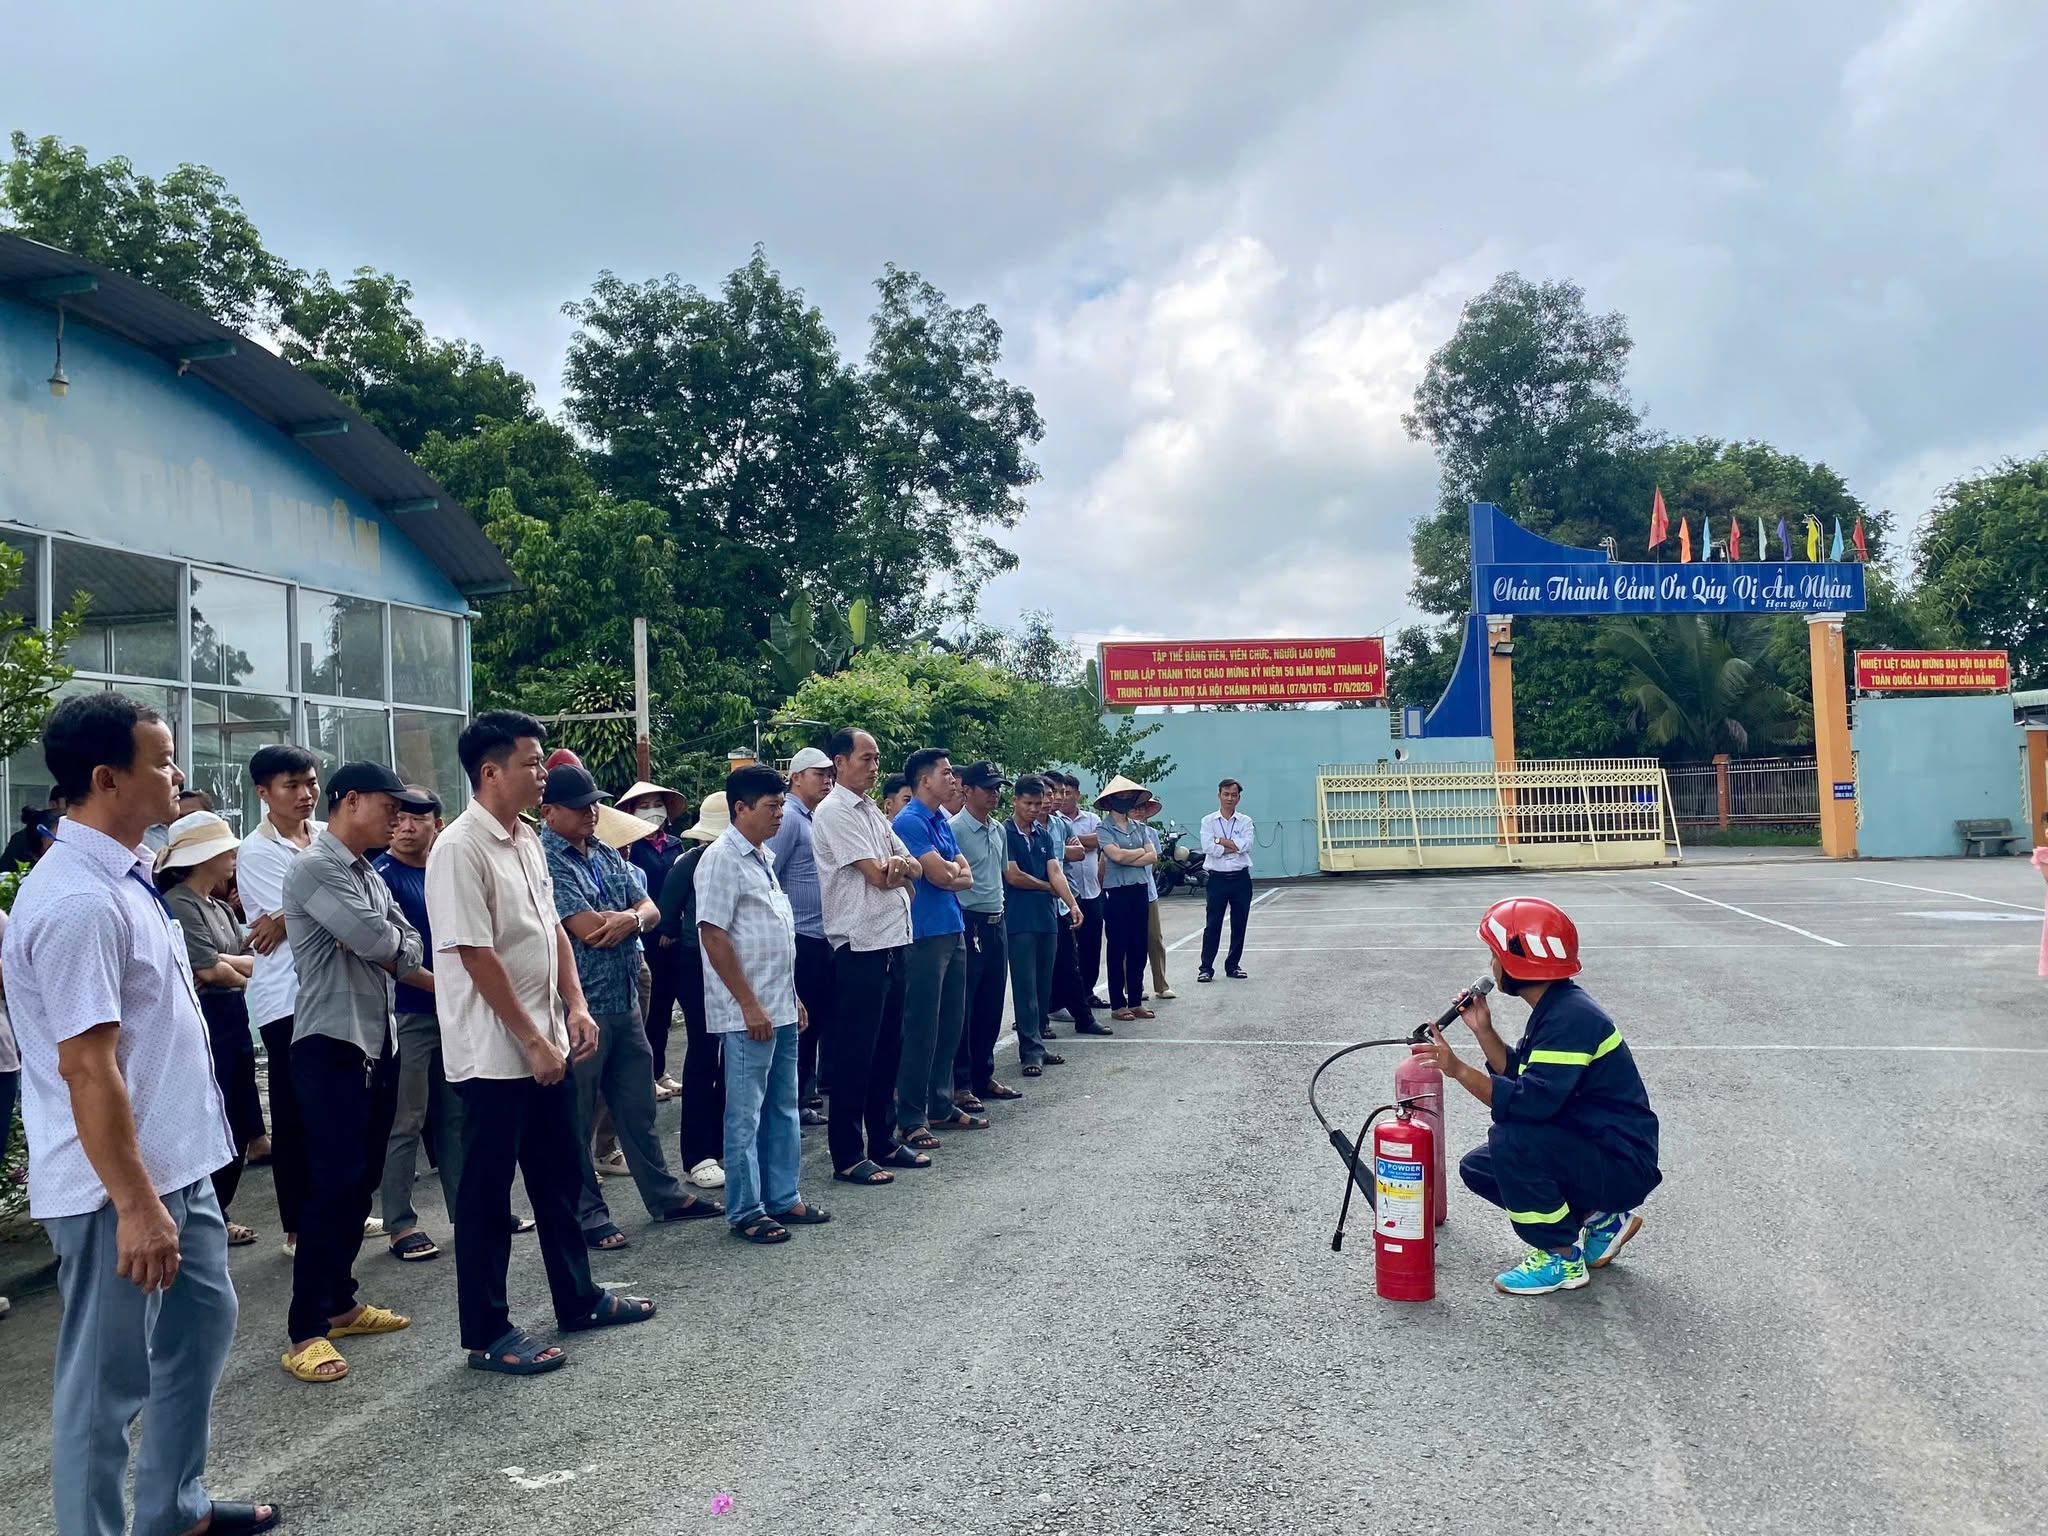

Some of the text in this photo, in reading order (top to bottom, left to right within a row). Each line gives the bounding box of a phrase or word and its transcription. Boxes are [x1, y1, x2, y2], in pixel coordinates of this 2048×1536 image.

[1493, 577, 1542, 601] Chân
[1547, 576, 1610, 601] Thành
[1614, 575, 1656, 600] Cảm
[1661, 573, 1687, 600] Ơn
[1733, 575, 1759, 605] Vị
[1762, 568, 1796, 599] Ân
[1800, 574, 1853, 599] Nhân
[1765, 600, 1787, 610] Hẹn
[1230, 647, 1247, 660] VIÊN
[1299, 649, 1313, 658] LAO
[1314, 647, 1336, 660] ĐỘNG
[1901, 657, 1920, 669] CHÀO
[1110, 670, 1121, 680] THI
[1141, 667, 1155, 682] LẬP
[1157, 667, 1183, 680] THÀNH
[1184, 666, 1202, 679] TÍCH
[1204, 666, 1224, 679] CHÀO
[1226, 665, 1249, 678] MỪNG
[1263, 664, 1282, 679] NIỆM
[1285, 667, 1294, 677] 50
[1296, 664, 1314, 676] NĂM
[1316, 663, 1335, 676] NGÀY
[1338, 662, 1362, 675] THÀNH
[1364, 662, 1378, 677] LẬP
[1946, 675, 1958, 685] XIV
[1117, 687, 1142, 698] TRUNG
[1145, 685, 1160, 697] TÂM
[1163, 683, 1178, 697] BẢO
[1197, 684, 1207, 696] XÃ
[1209, 683, 1222, 698] HỘI
[1224, 683, 1250, 696] CHÁNH
[1252, 682, 1267, 695] PHÚ
[1287, 683, 1327, 694] (07/9/1976
[1333, 682, 1373, 693] 07/9/2026)
[1388, 1163, 1421, 1172] POWDER
